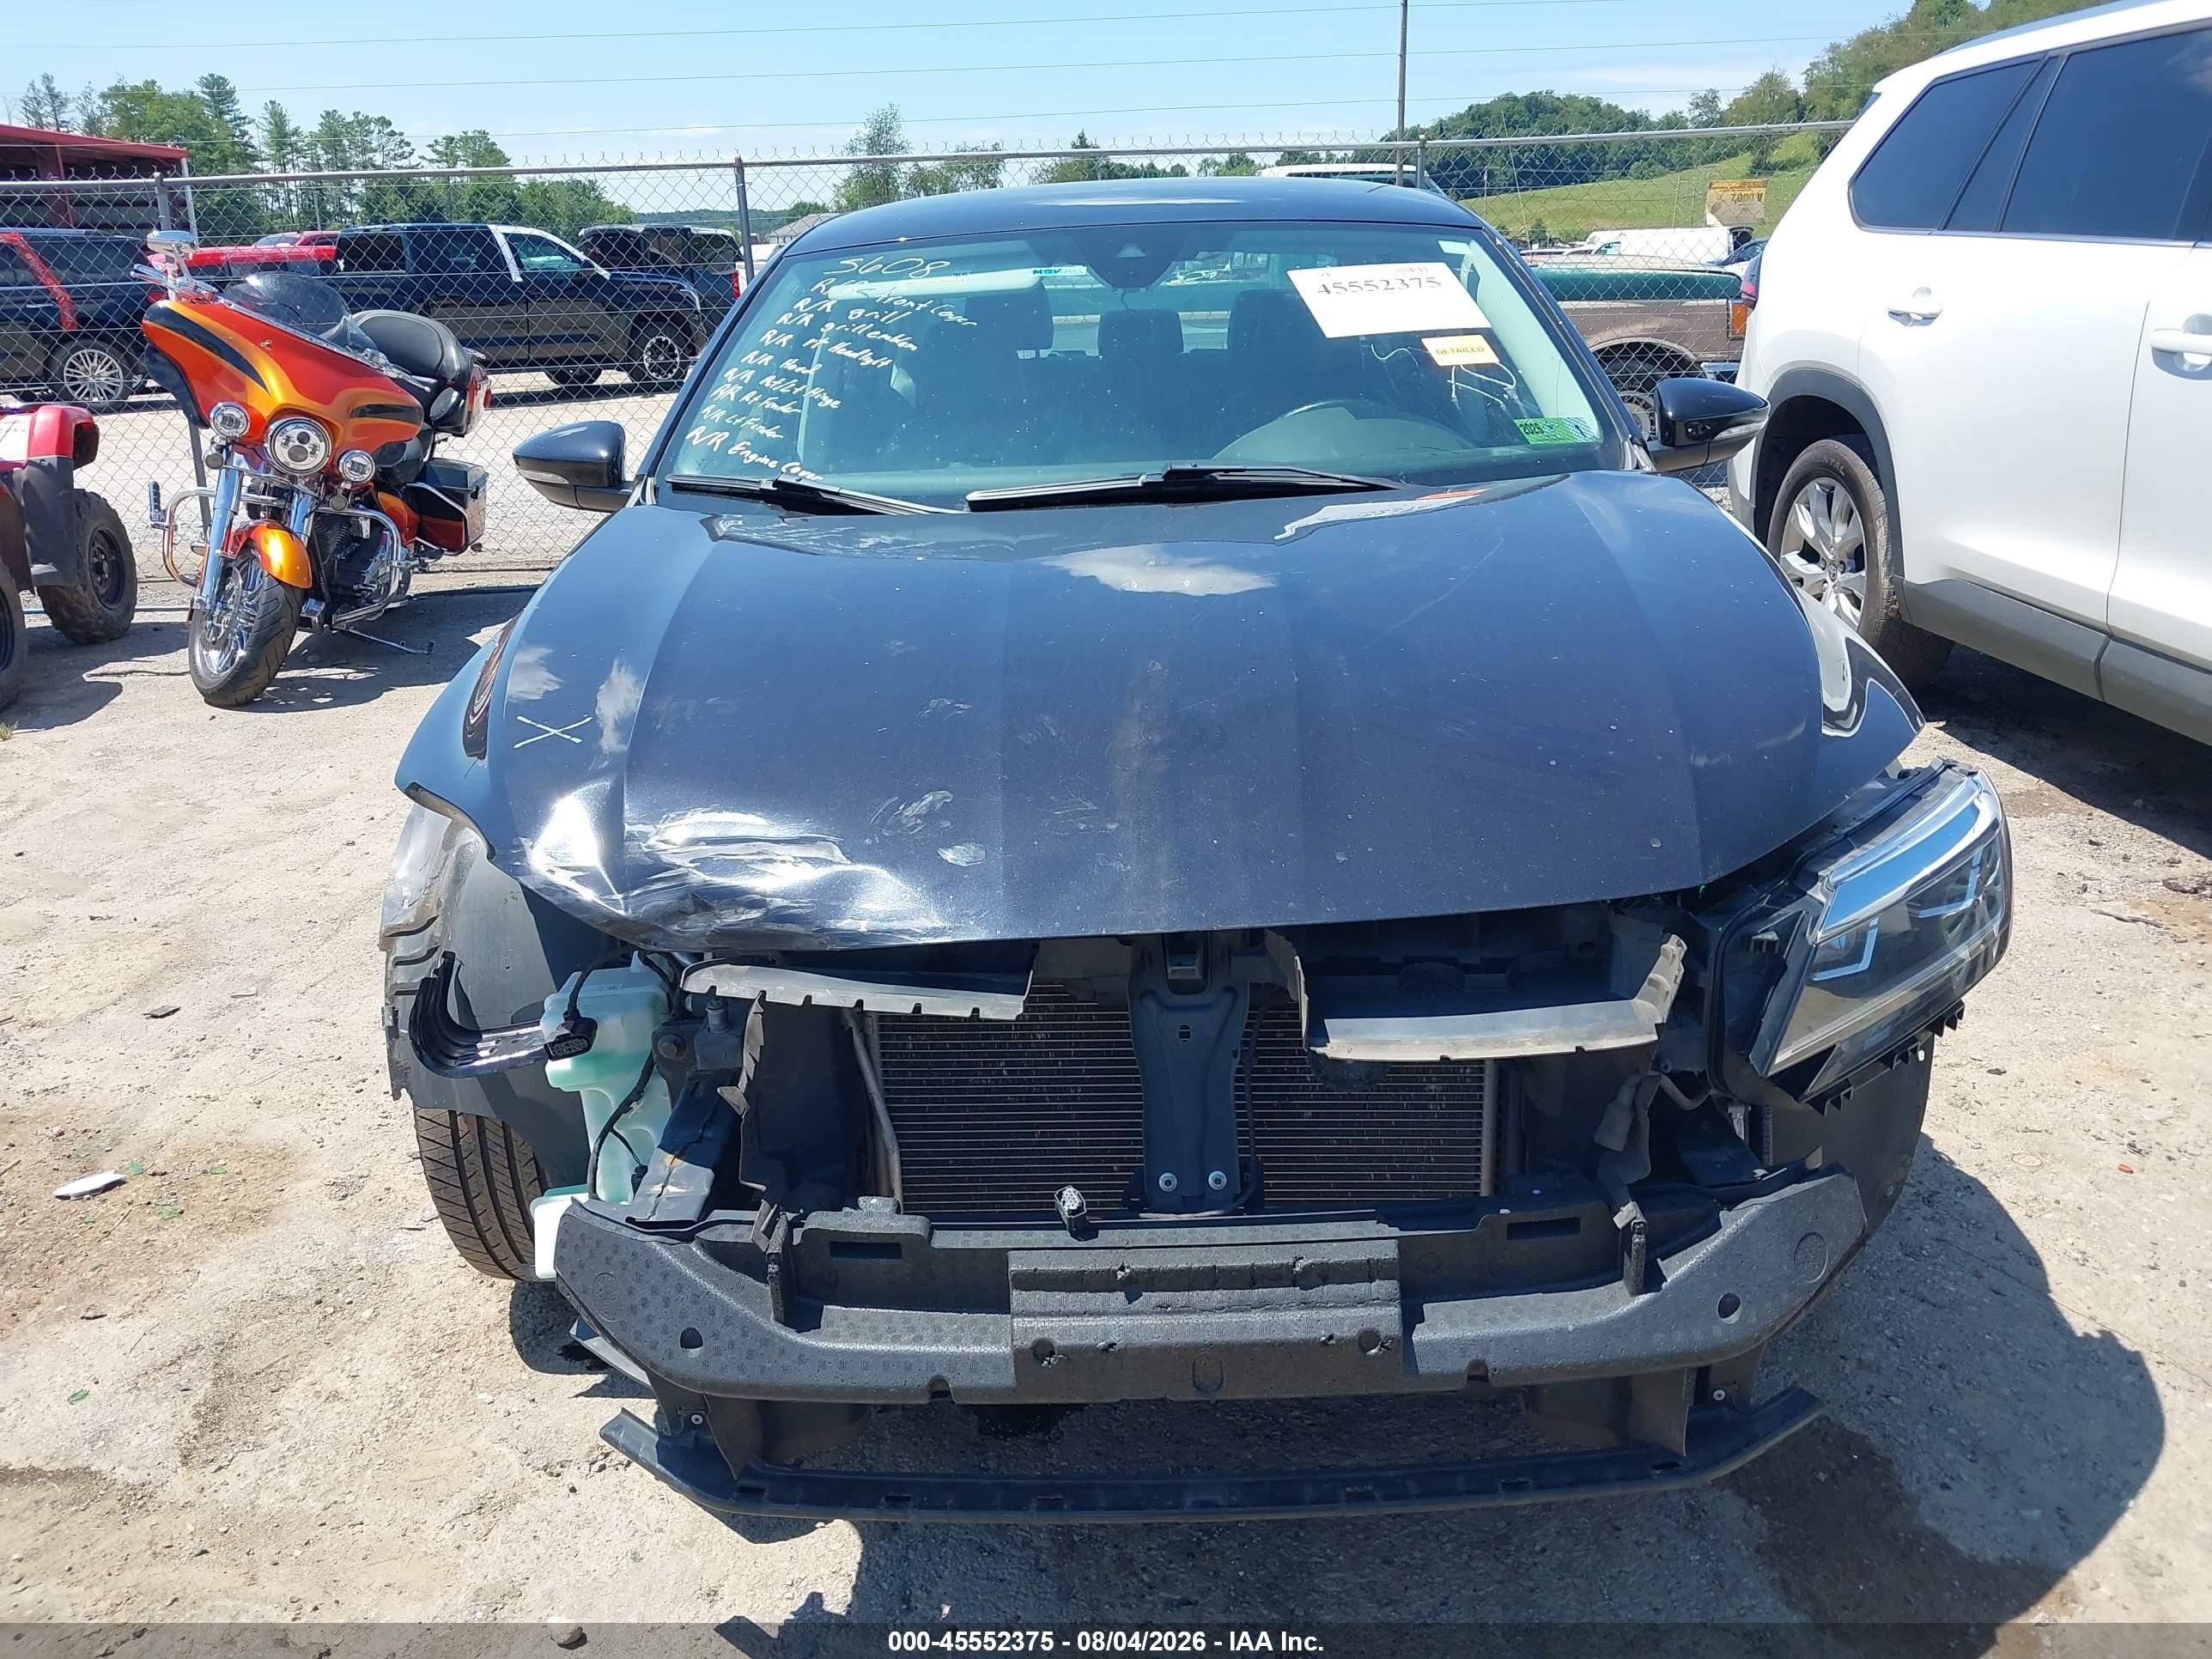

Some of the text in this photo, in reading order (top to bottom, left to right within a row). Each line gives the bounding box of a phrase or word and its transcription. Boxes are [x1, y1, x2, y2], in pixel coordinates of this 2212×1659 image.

[1317, 276, 1442, 295] 45552375
[1435, 346, 1485, 355] DETAILED
[1519, 422, 1545, 435] 2026
[728, 441, 779, 468] Engine
